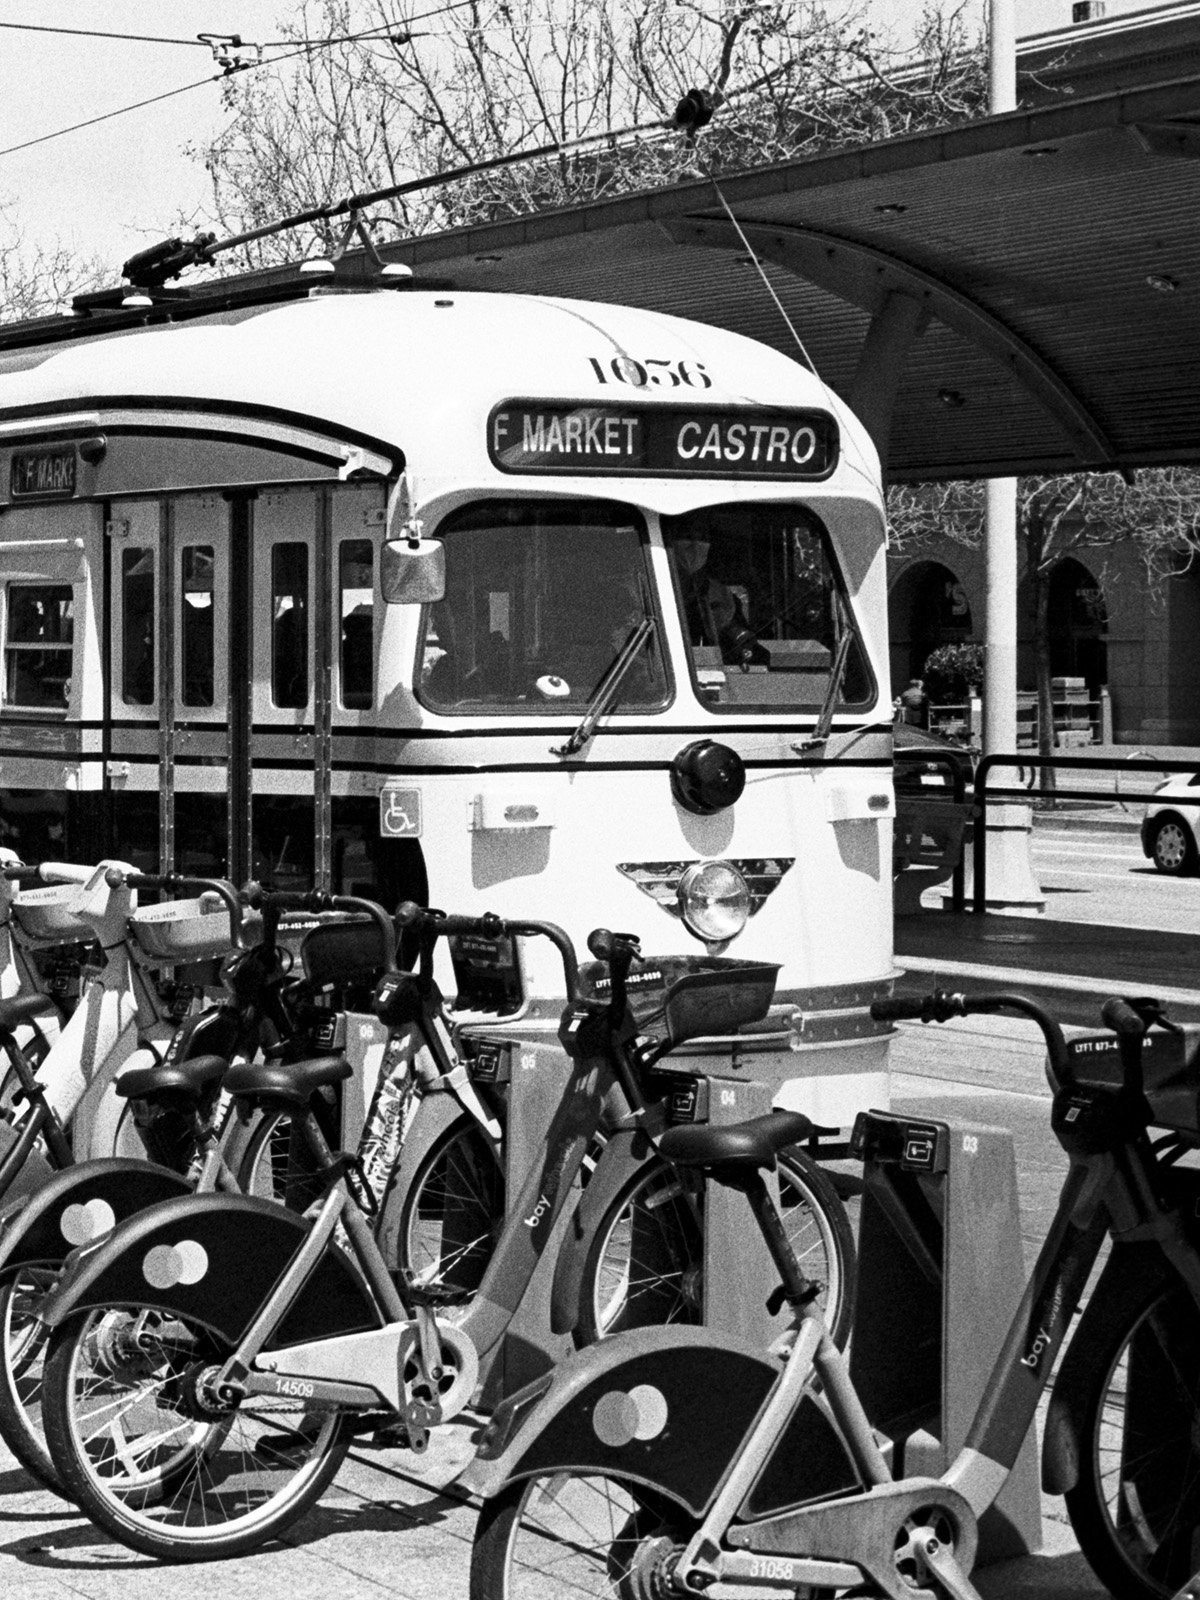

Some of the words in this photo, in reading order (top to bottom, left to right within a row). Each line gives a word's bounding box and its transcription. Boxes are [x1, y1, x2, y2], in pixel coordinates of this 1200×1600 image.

[586, 356, 712, 389] 1056
[494, 413, 510, 451] F
[523, 414, 638, 455] MARKET
[677, 421, 816, 464] CASTRO
[1075, 1042, 1093, 1053] LYFT
[721, 1090, 736, 1105] 04
[963, 1135, 978, 1153] 03
[524, 1194, 551, 1227] bay
[1020, 1327, 1051, 1367] bay
[275, 1380, 314, 1397] 14509
[750, 1559, 793, 1580] 31058
